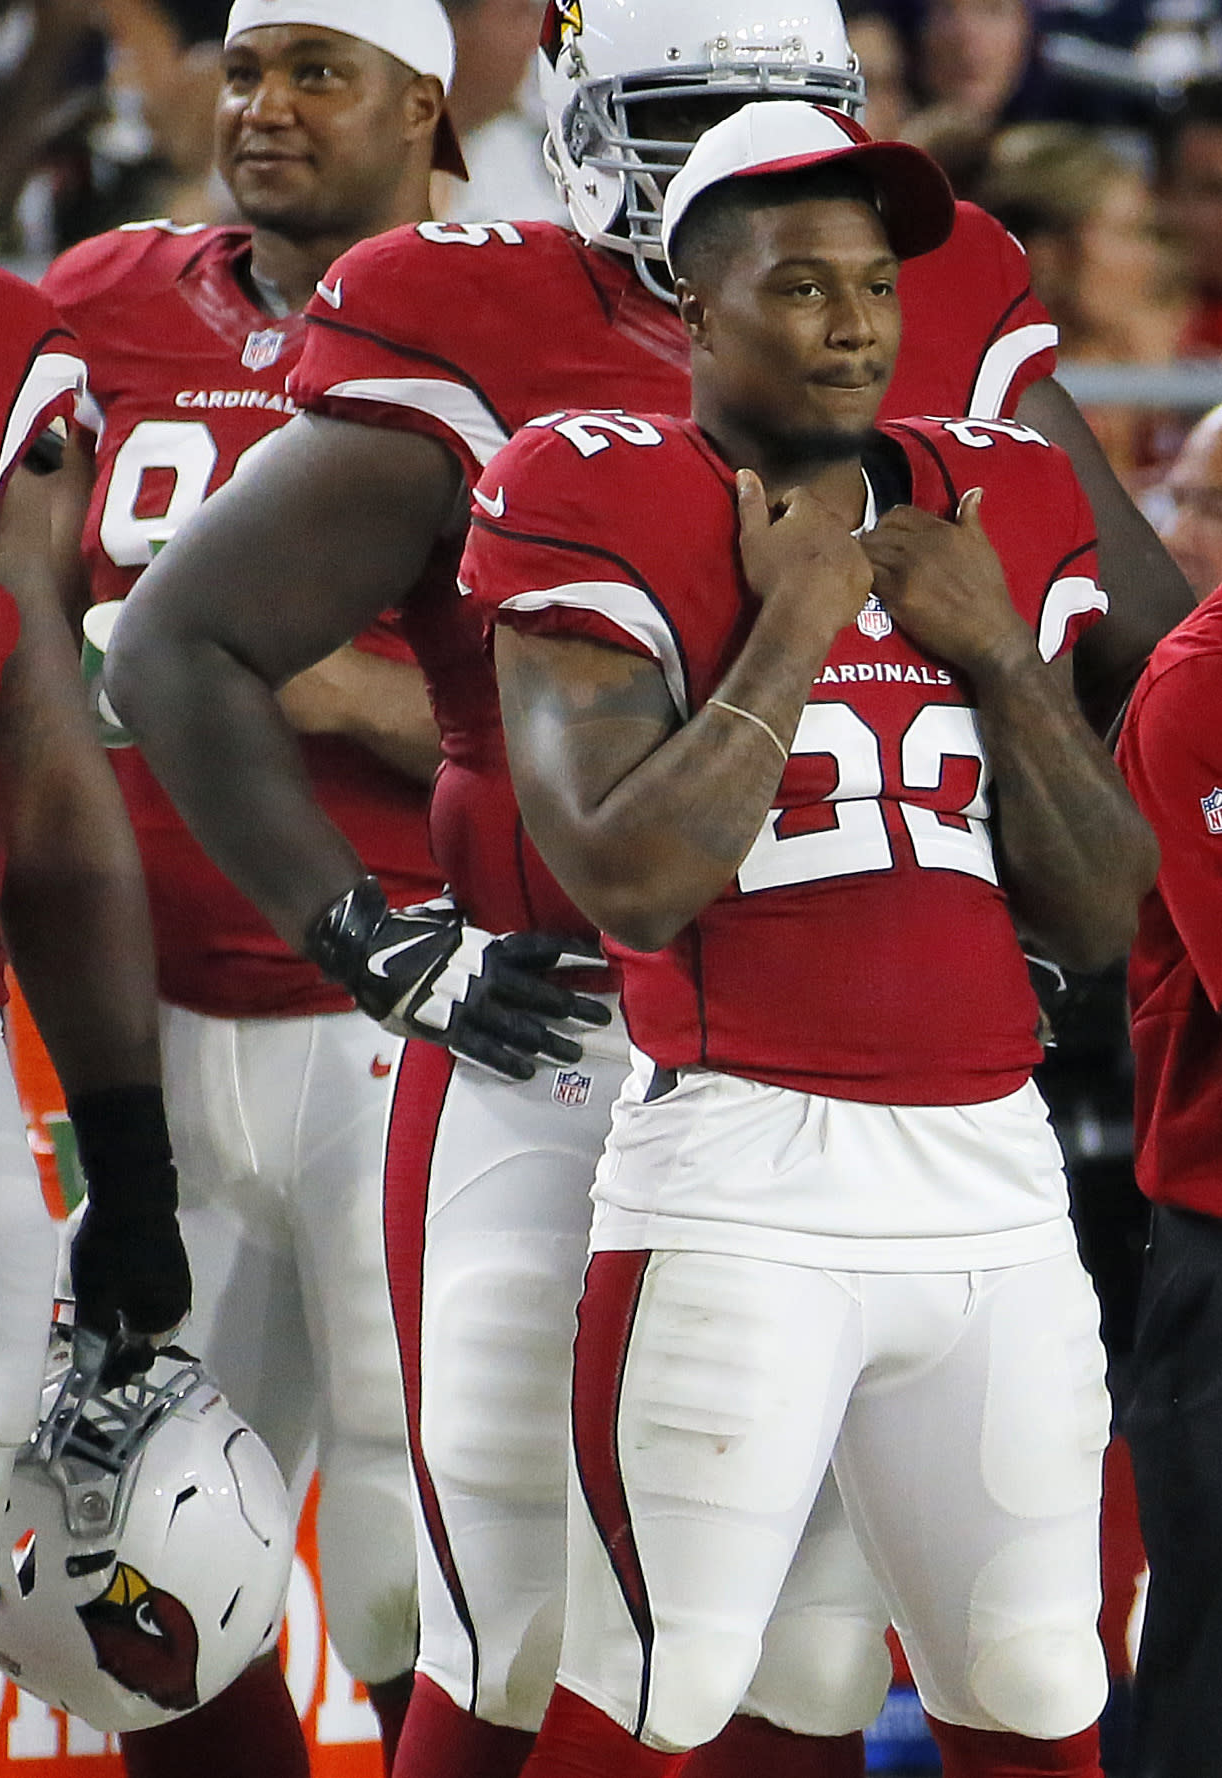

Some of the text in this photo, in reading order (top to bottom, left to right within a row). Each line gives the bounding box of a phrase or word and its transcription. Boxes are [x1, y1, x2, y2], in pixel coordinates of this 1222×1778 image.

[175, 390, 306, 415] CARDINAL
[863, 612, 888, 629] NFL
[813, 663, 951, 685] ARDINALS
[737, 702, 999, 894] 22
[557, 1083, 585, 1104] NFL
